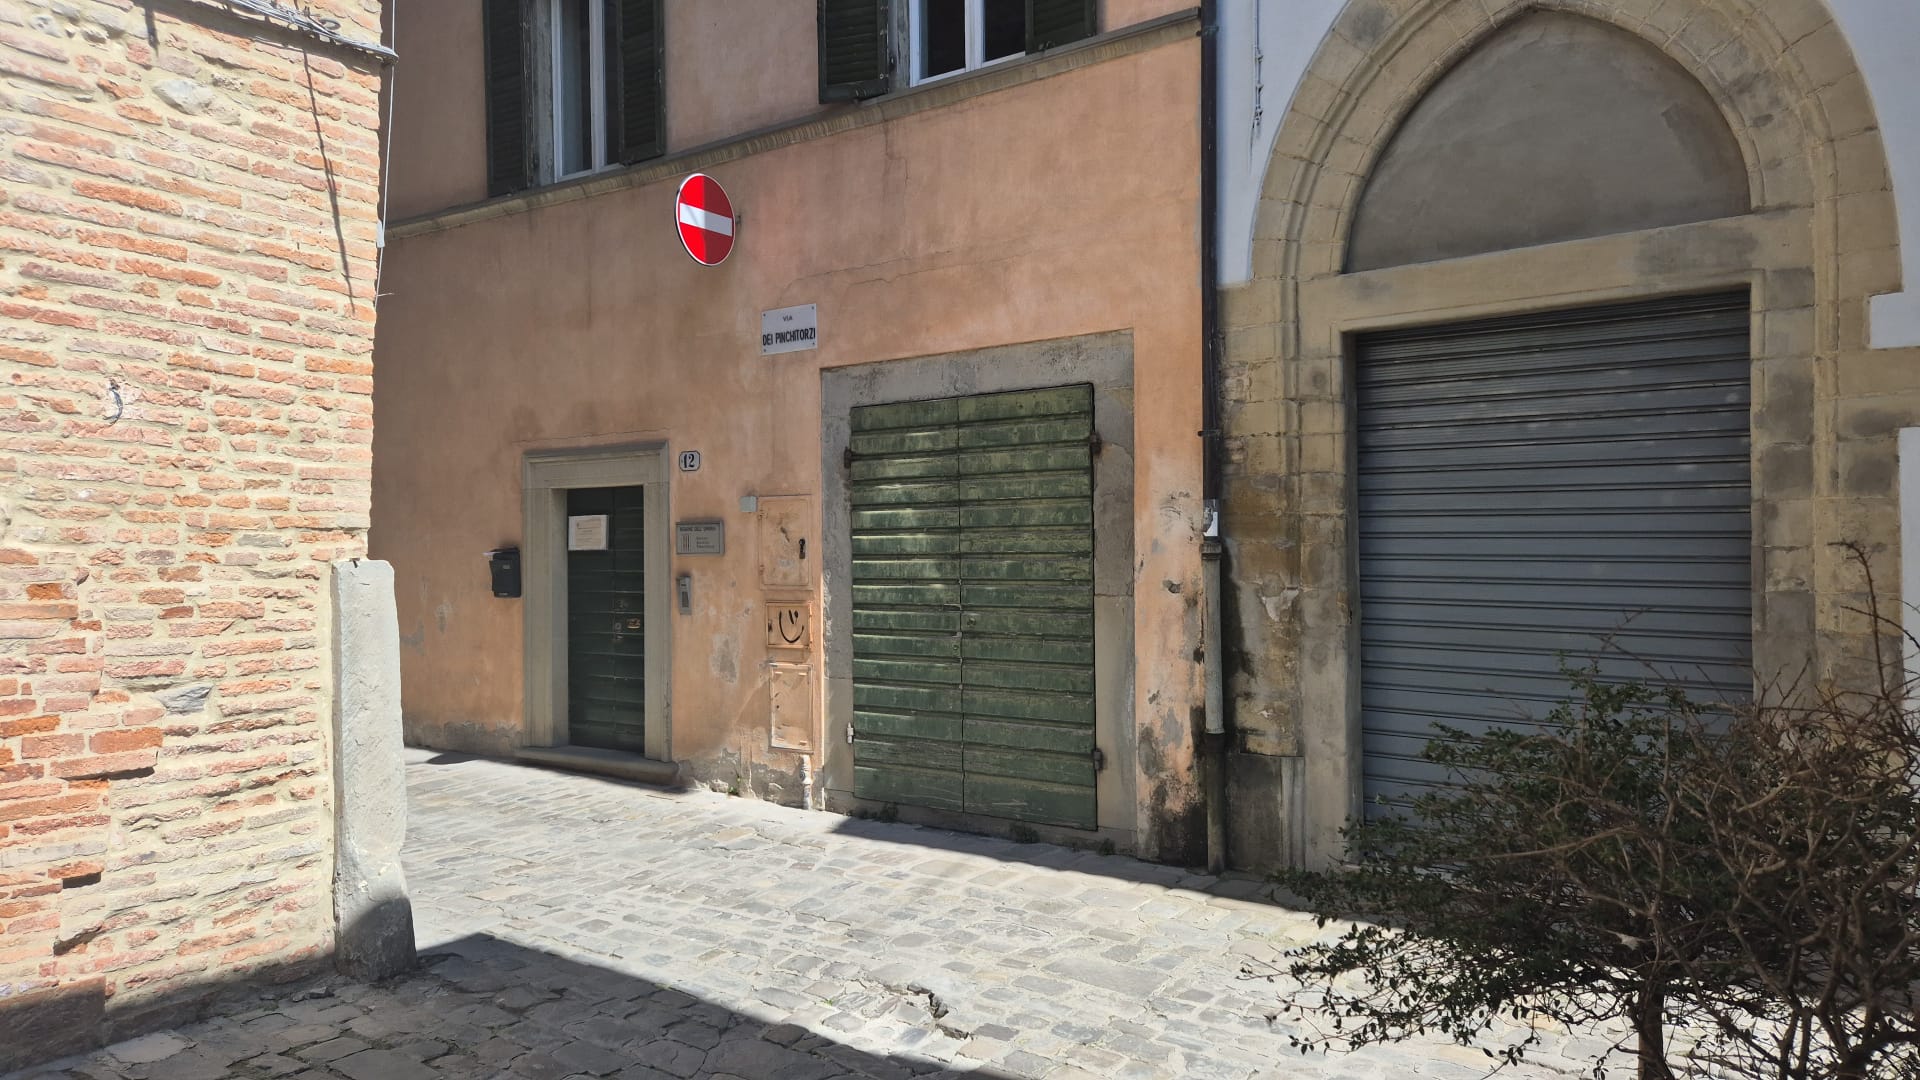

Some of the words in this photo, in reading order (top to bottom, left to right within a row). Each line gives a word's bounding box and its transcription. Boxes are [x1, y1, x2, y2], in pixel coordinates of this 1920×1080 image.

[762, 333, 774, 346] DEI
[775, 327, 816, 344] PINCHITORZI
[683, 453, 695, 468] 12
